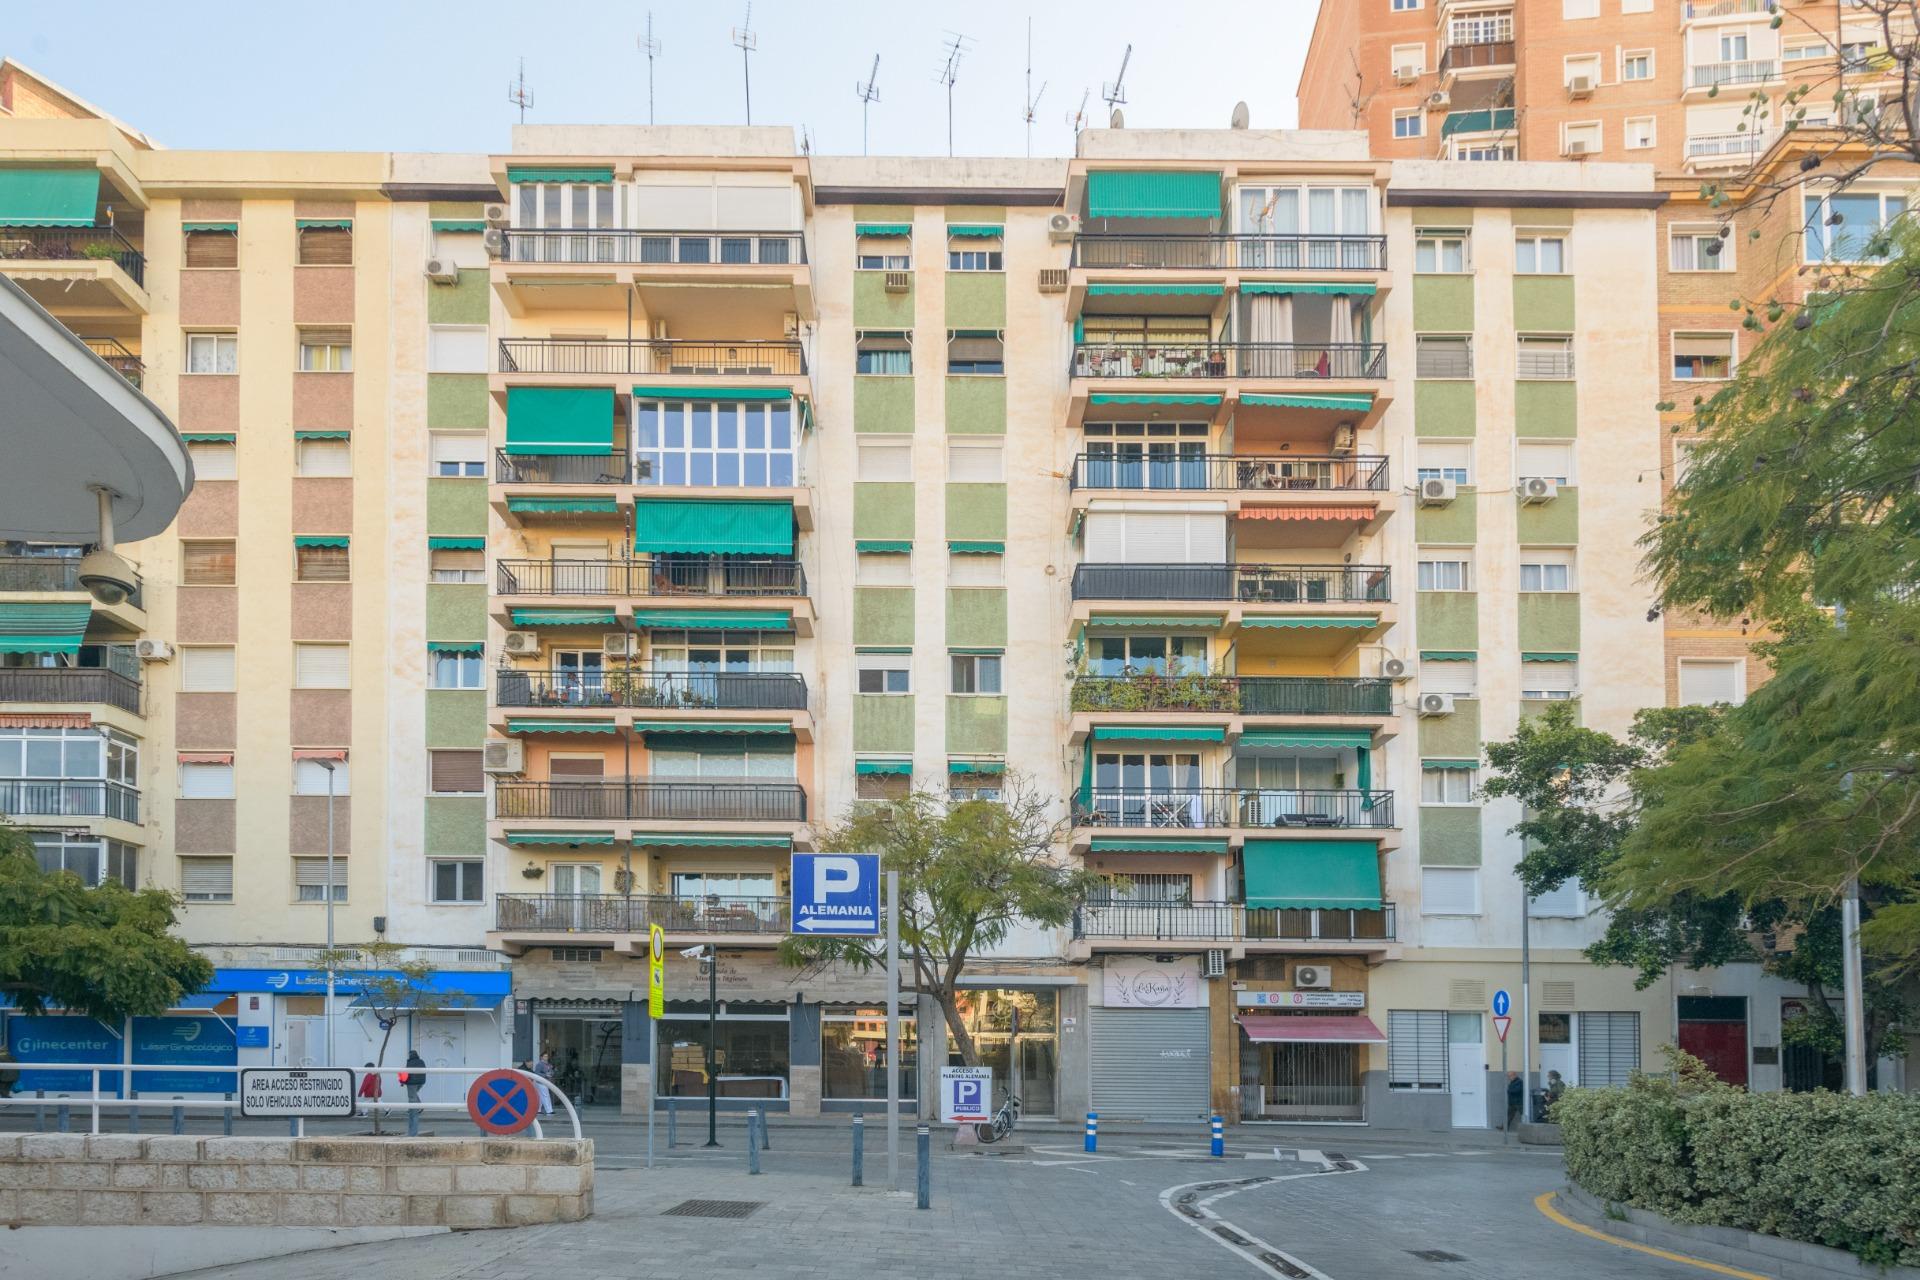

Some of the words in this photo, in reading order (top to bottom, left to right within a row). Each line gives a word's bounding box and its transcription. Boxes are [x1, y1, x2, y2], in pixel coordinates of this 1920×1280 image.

[813, 857, 860, 904] P
[799, 905, 873, 916] ALEMANIA
[252, 1079, 270, 1091] AREA
[271, 1079, 298, 1091] ACCESO
[299, 1079, 343, 1091] RESTRINGIDO
[958, 1081, 977, 1104] P
[246, 1096, 264, 1108] SOLO
[265, 1096, 302, 1108] VEHICULOS
[303, 1096, 349, 1108] AUTORIZADOS
